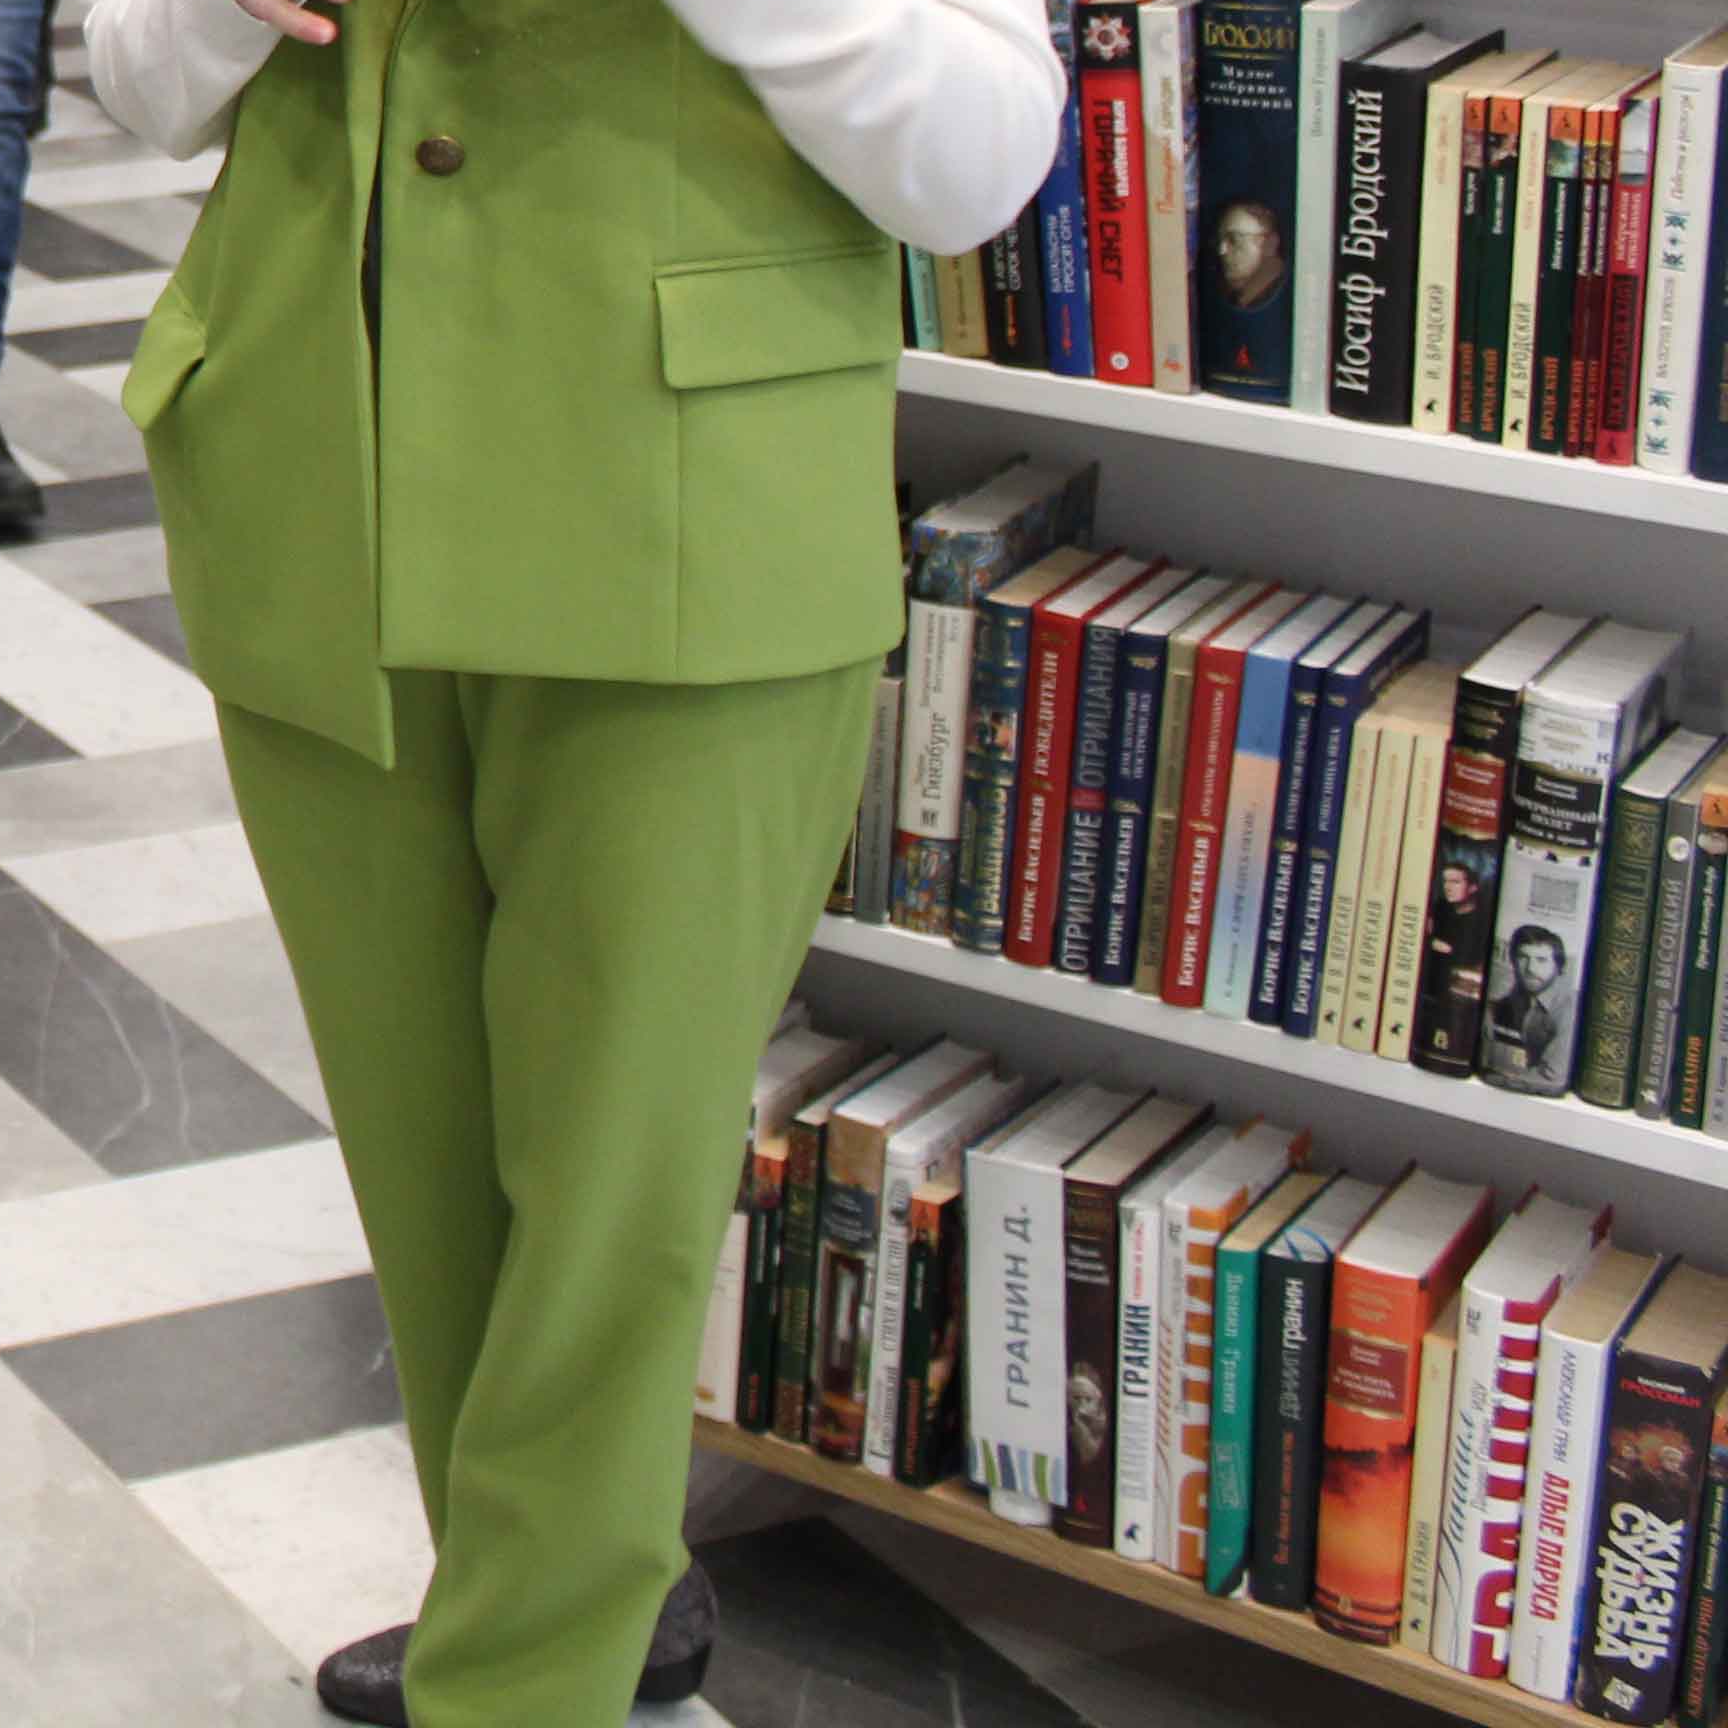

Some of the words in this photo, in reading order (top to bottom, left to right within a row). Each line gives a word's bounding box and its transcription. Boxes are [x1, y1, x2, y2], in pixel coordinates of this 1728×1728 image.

[1341, 88, 1388, 259] Бродский
[1099, 221, 1124, 283] СНЕГ
[1335, 274, 1385, 393] Иосиф
[1425, 284, 1445, 360] БРОДСКИЙ
[1511, 302, 1532, 380] БРОДСКИЙ
[1540, 356, 1559, 440] БРОДСКИЙ
[1034, 652, 1058, 775] ПОБЕДИТЕЛИ
[922, 712, 949, 800] Гинзбург
[1059, 813, 1101, 971] ОТРИЦАНИЕ
[1080, 626, 1116, 788] ОТРИЦАНИЯ
[1329, 896, 1352, 960] ВЕРЕСАЕВ
[1359, 901, 1382, 967] ВЕРЕСАЕВ
[1395, 905, 1418, 971] ВЕРЕСАЕВ
[1655, 878, 1683, 989] ВЫСОЦКИЙ
[1680, 1036, 1701, 1114] ГАЗДАНОВ
[1003, 1207, 1031, 1242] Д.
[1003, 1254, 1029, 1408] ГРАНИН
[1123, 1305, 1150, 1398] ГРАНИН
[1282, 1280, 1305, 1349] гранин
[1222, 1347, 1242, 1414] Гранин
[1556, 1351, 1577, 1426] АЛЕКСАНДР
[1551, 1430, 1569, 1463] ГРИН
[1538, 1472, 1569, 1538] АЛЫЕ
[1413, 1521, 1430, 1572] ГРАНИН
[1529, 1540, 1566, 1621] ПАРУСА
[1594, 1502, 1646, 1657] СУДЬБА
[1628, 1511, 1684, 1671] ЖИЗНЬ
